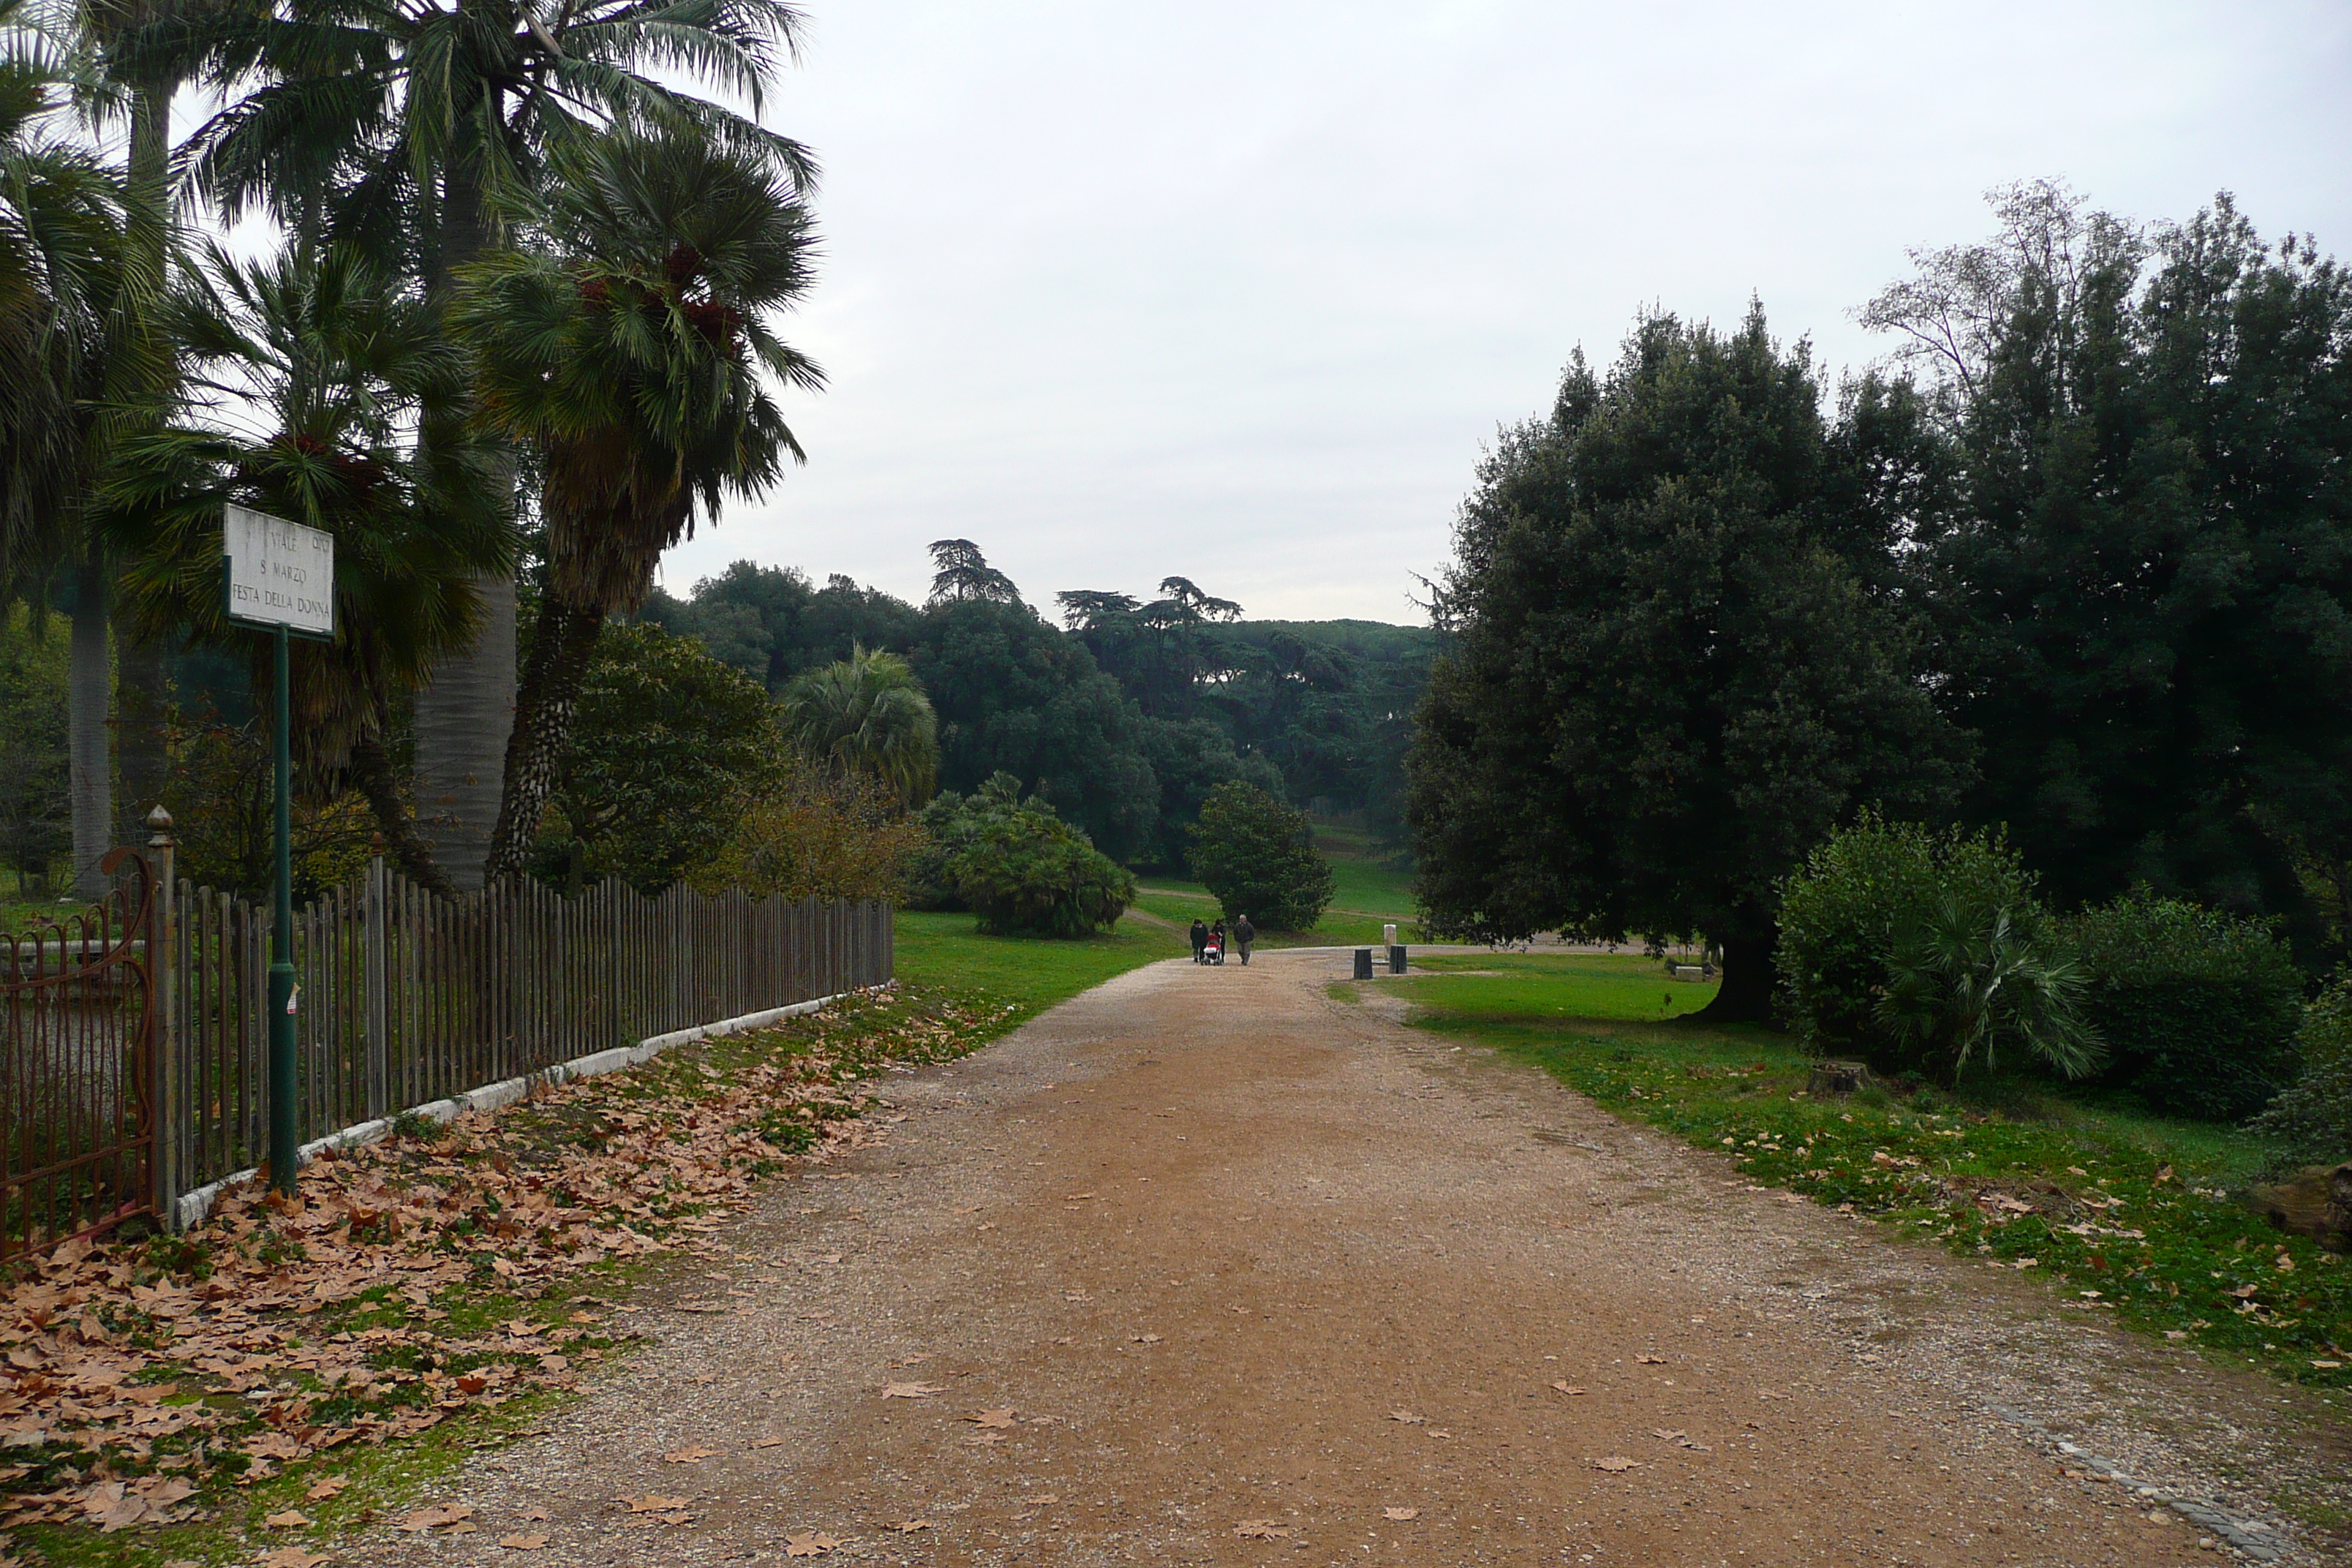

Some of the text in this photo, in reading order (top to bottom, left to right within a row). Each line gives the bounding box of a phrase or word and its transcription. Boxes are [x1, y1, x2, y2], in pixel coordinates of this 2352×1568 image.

[271, 532, 296, 552] VIALE
[273, 562, 306, 584] MARZO
[233, 584, 330, 618] FESTA DELLA DONNA
